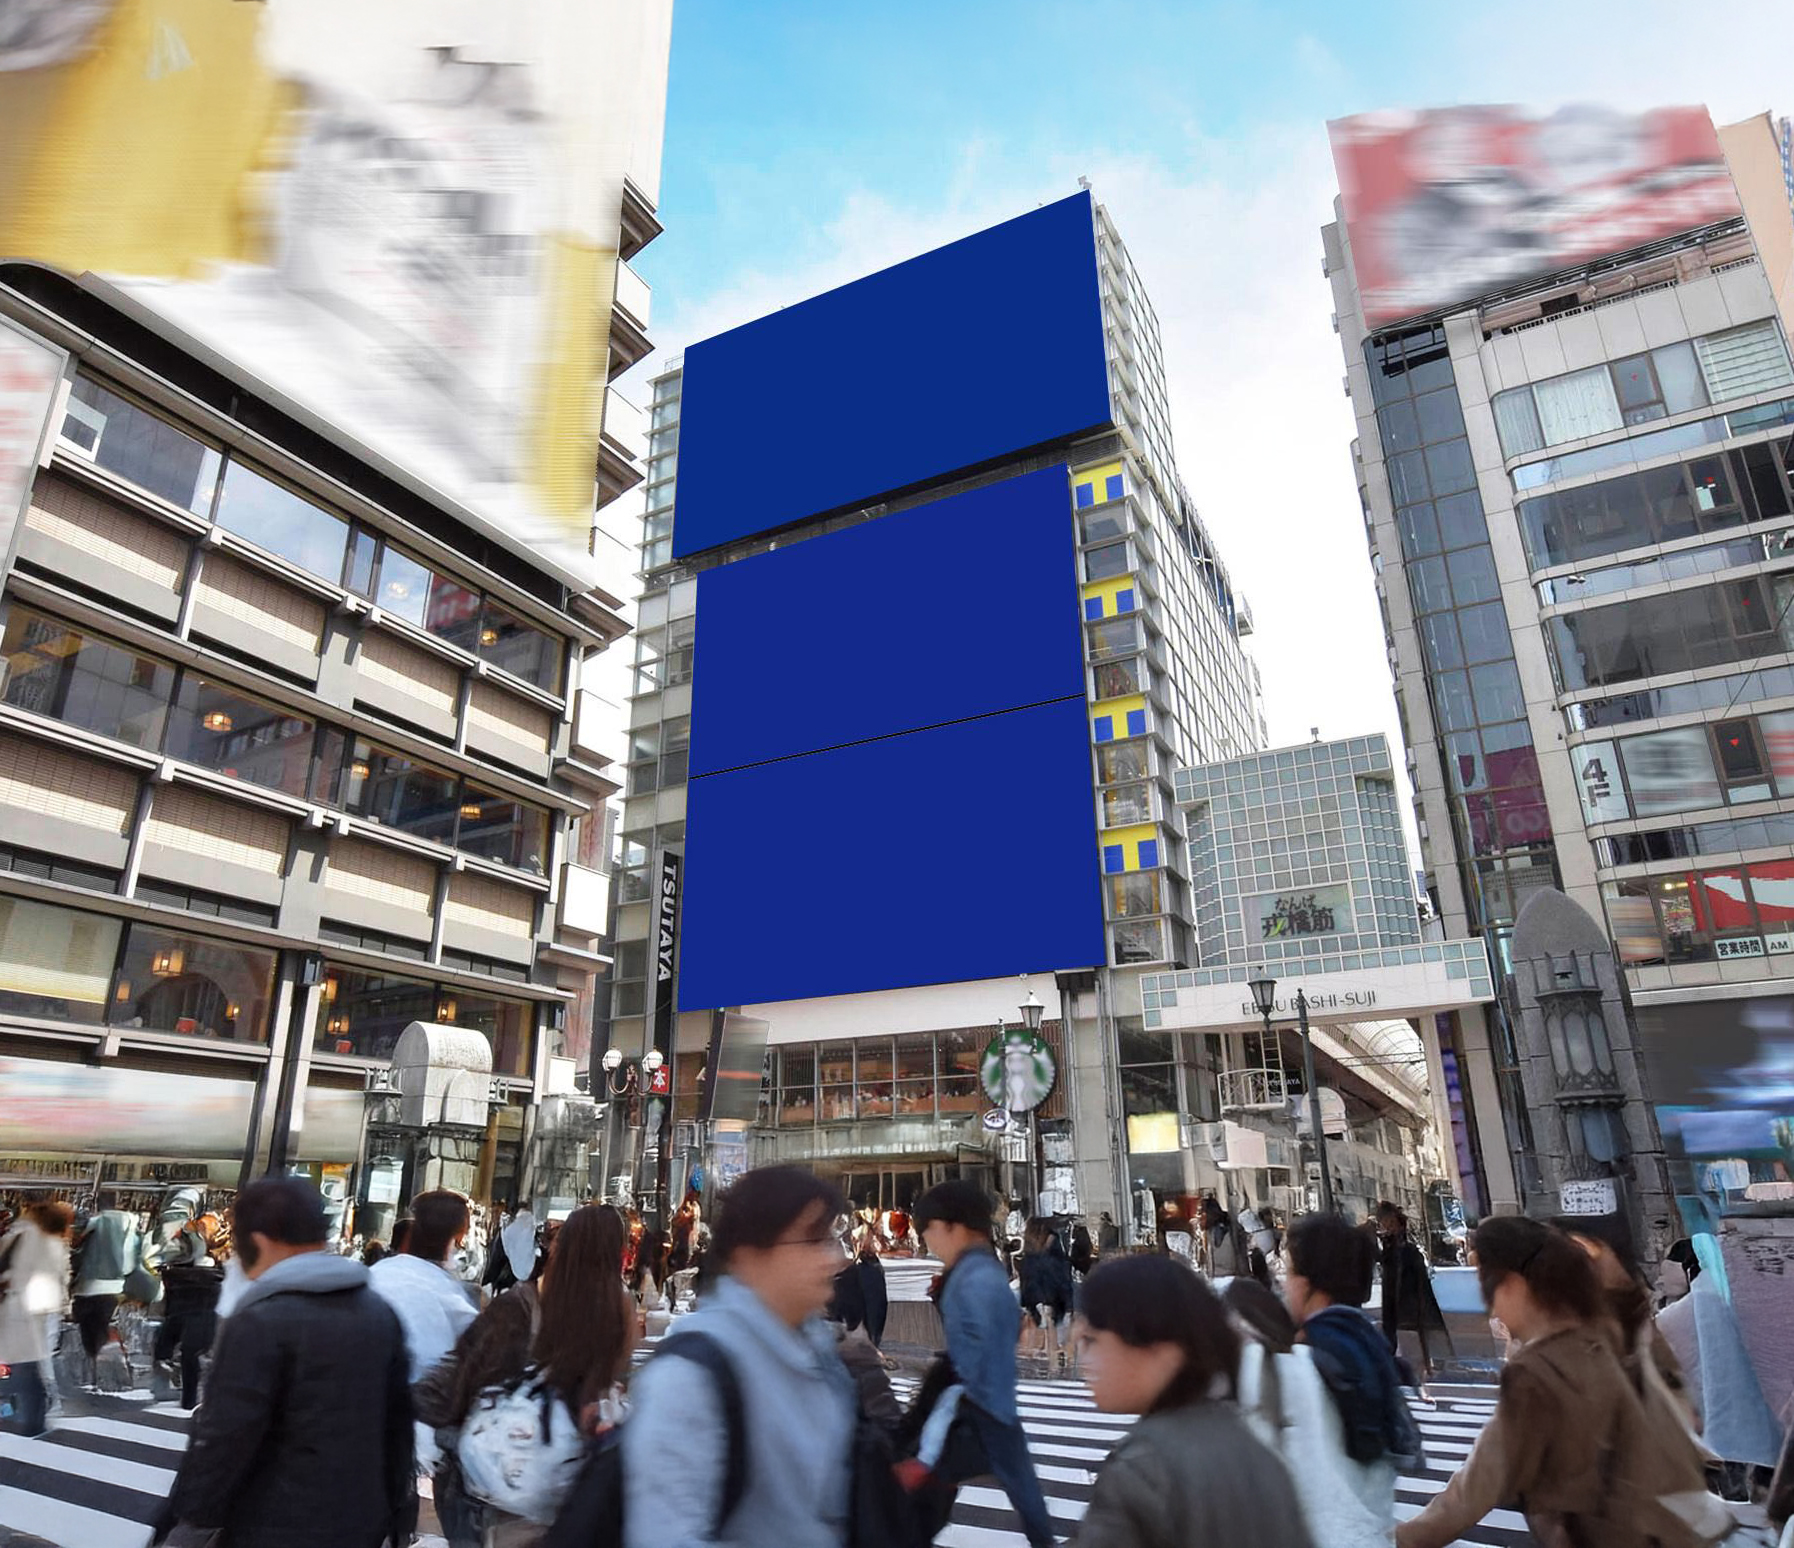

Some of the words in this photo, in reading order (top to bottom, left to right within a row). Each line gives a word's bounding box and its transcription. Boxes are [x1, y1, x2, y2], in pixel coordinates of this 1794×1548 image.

[1275, 894, 1316, 911] なんば
[658, 864, 677, 981] TSUTAYA
[1717, 940, 1762, 956] 営業時間
[1770, 941, 1790, 951] AM
[1242, 998, 1287, 1015] EBU
